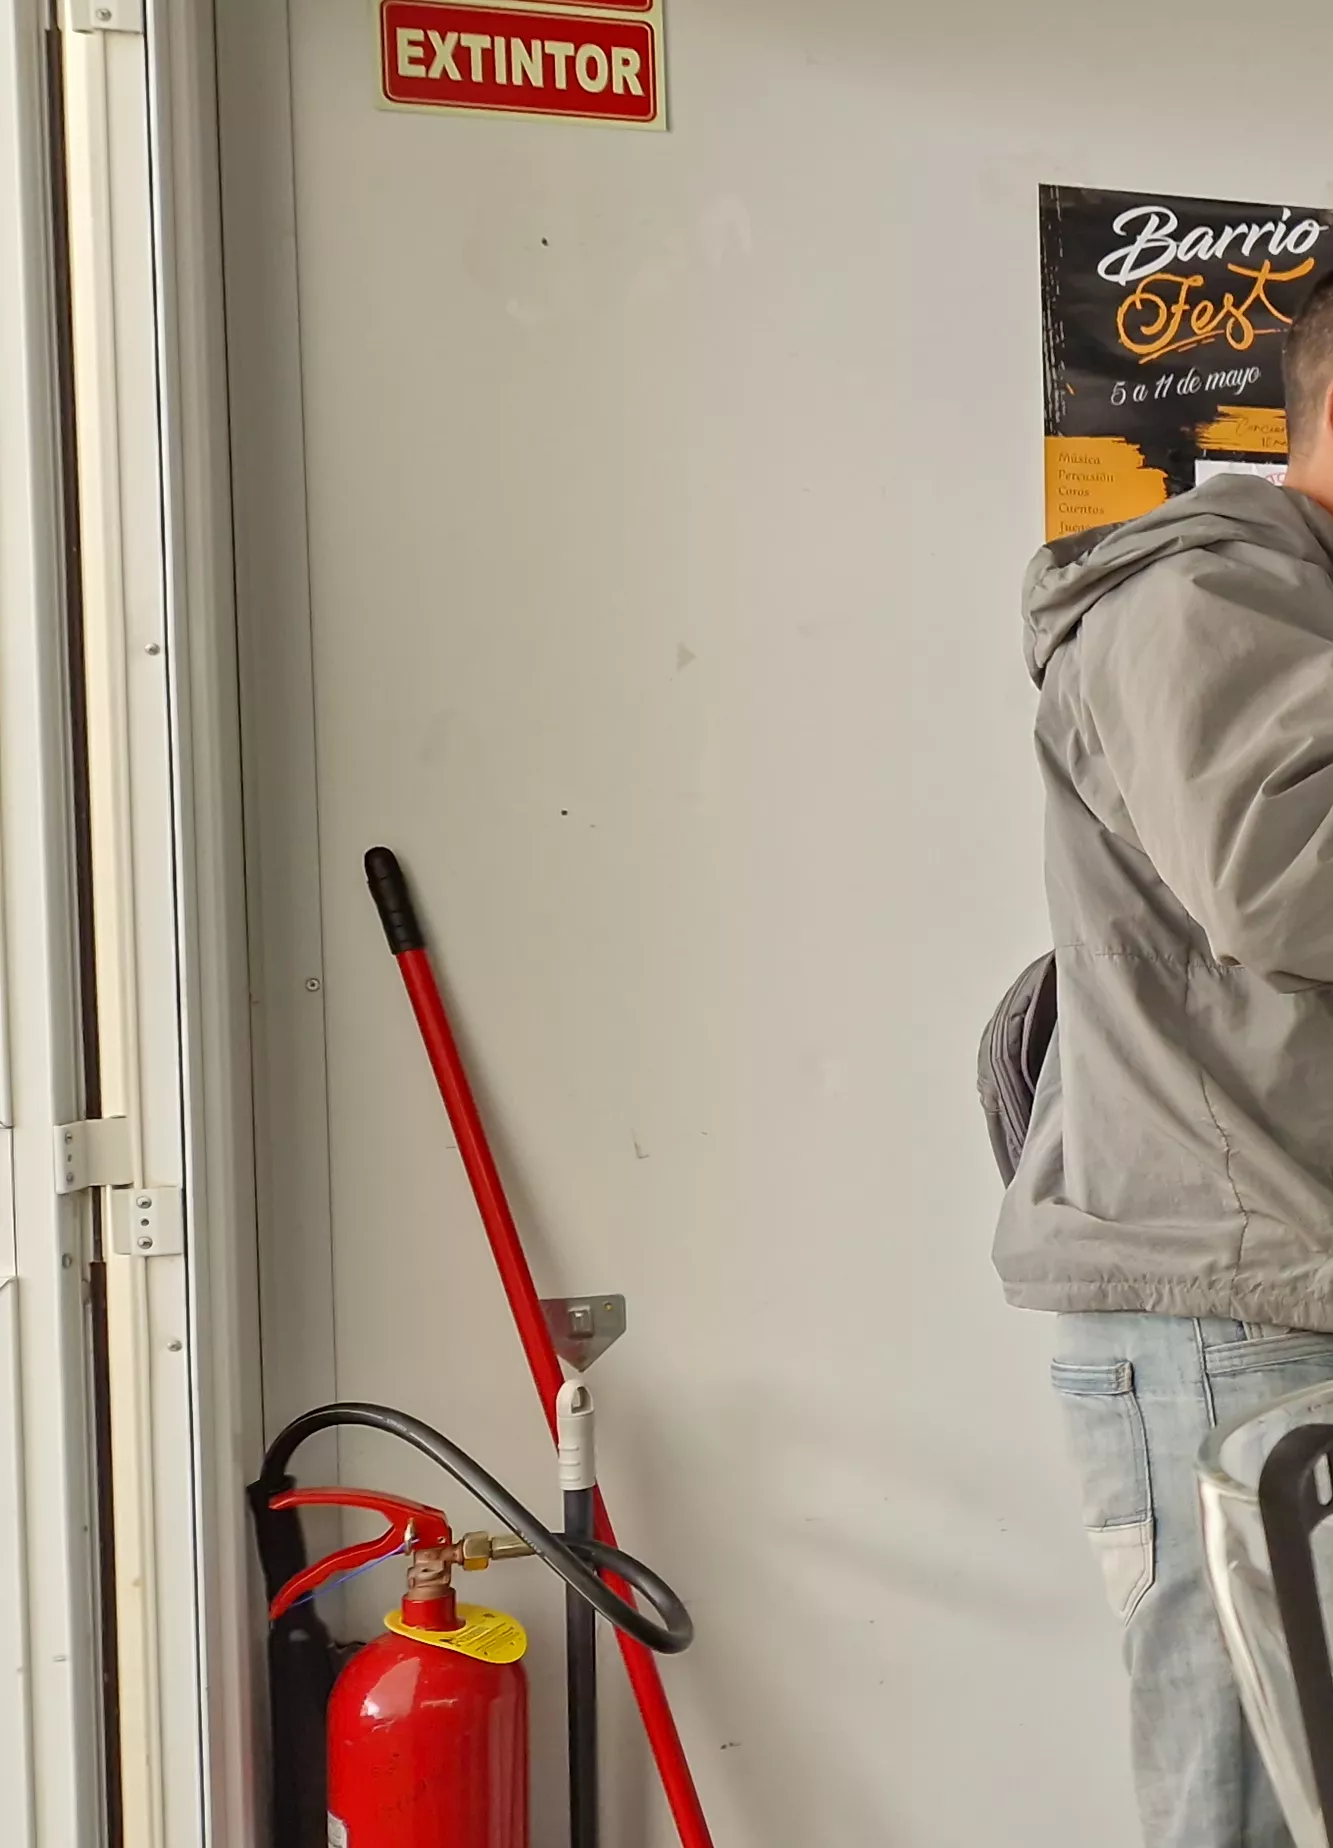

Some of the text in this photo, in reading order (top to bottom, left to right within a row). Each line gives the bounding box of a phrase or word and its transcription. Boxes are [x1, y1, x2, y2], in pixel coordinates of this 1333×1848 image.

[396, 27, 645, 96] EXTINTOR
[1097, 206, 1329, 286] Barrio
[1116, 257, 1315, 355] Fest
[1110, 366, 1261, 406] 5 a 11 de mayo
[1058, 452, 1101, 465] Música
[1058, 468, 1114, 482] Percusión
[1058, 486, 1089, 497] Coros
[1058, 502, 1105, 515] Cuentos
